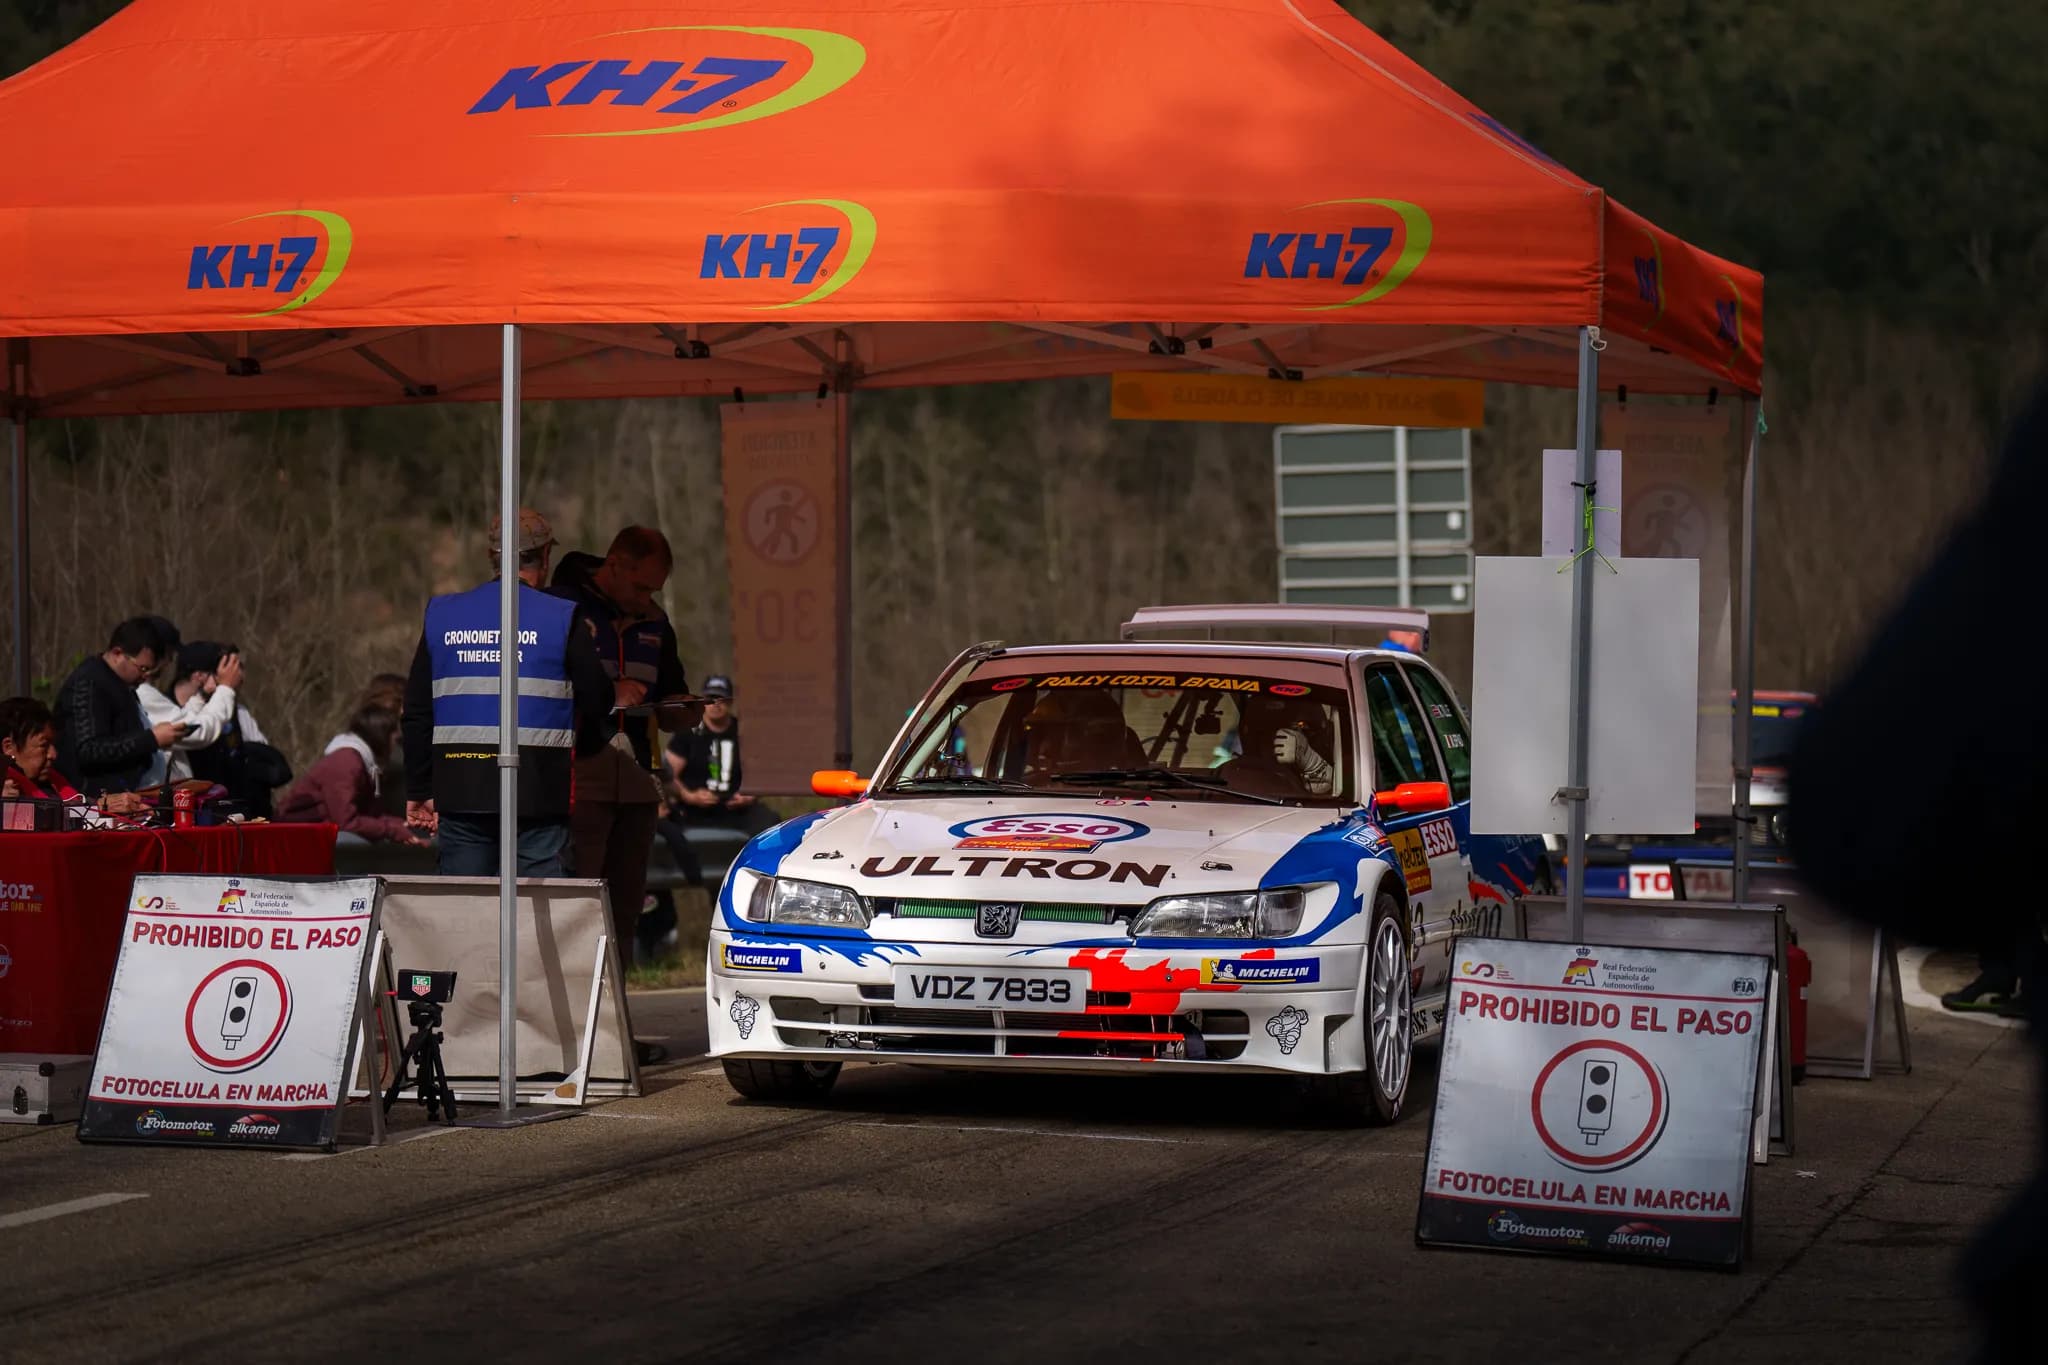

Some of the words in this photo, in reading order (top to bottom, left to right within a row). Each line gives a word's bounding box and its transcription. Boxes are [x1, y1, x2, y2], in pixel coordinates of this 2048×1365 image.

[444, 629, 538, 646] CRONOMETOR
[456, 649, 523, 663] TIMEKEER
[1037, 675, 1109, 688] RALLY
[1109, 675, 1176, 687] COSTA
[1180, 676, 1260, 692] BRAVA
[1420, 819, 1457, 857] ESSO
[860, 856, 1171, 888] ULTRON
[132, 921, 263, 950] PROHIBIDO
[270, 928, 299, 950] EL
[305, 926, 362, 950] PASO
[733, 954, 790, 966] MICHELIN
[1238, 967, 1310, 978] MICHELIN
[910, 974, 976, 1000] VDZ
[983, 976, 1071, 1003] 7833
[1734, 980, 1757, 993] FIA
[1459, 991, 1620, 1029] PROHIBIDO
[1630, 1005, 1667, 1032] EL
[1677, 1008, 1751, 1035] PASO
[102, 1076, 220, 1100] FOTOCELULA
[226, 1084, 251, 1100] EN
[256, 1083, 328, 1102] MARCHA
[143, 1116, 214, 1131] Fotomotor
[229, 1123, 280, 1135] alkamel
[1438, 1169, 1587, 1204] FOTOCELULA
[1594, 1185, 1627, 1207] EN
[1633, 1188, 1731, 1211] MARCHA
[1496, 1219, 1584, 1239] Fotomotor
[1608, 1232, 1671, 1249] alkamel
